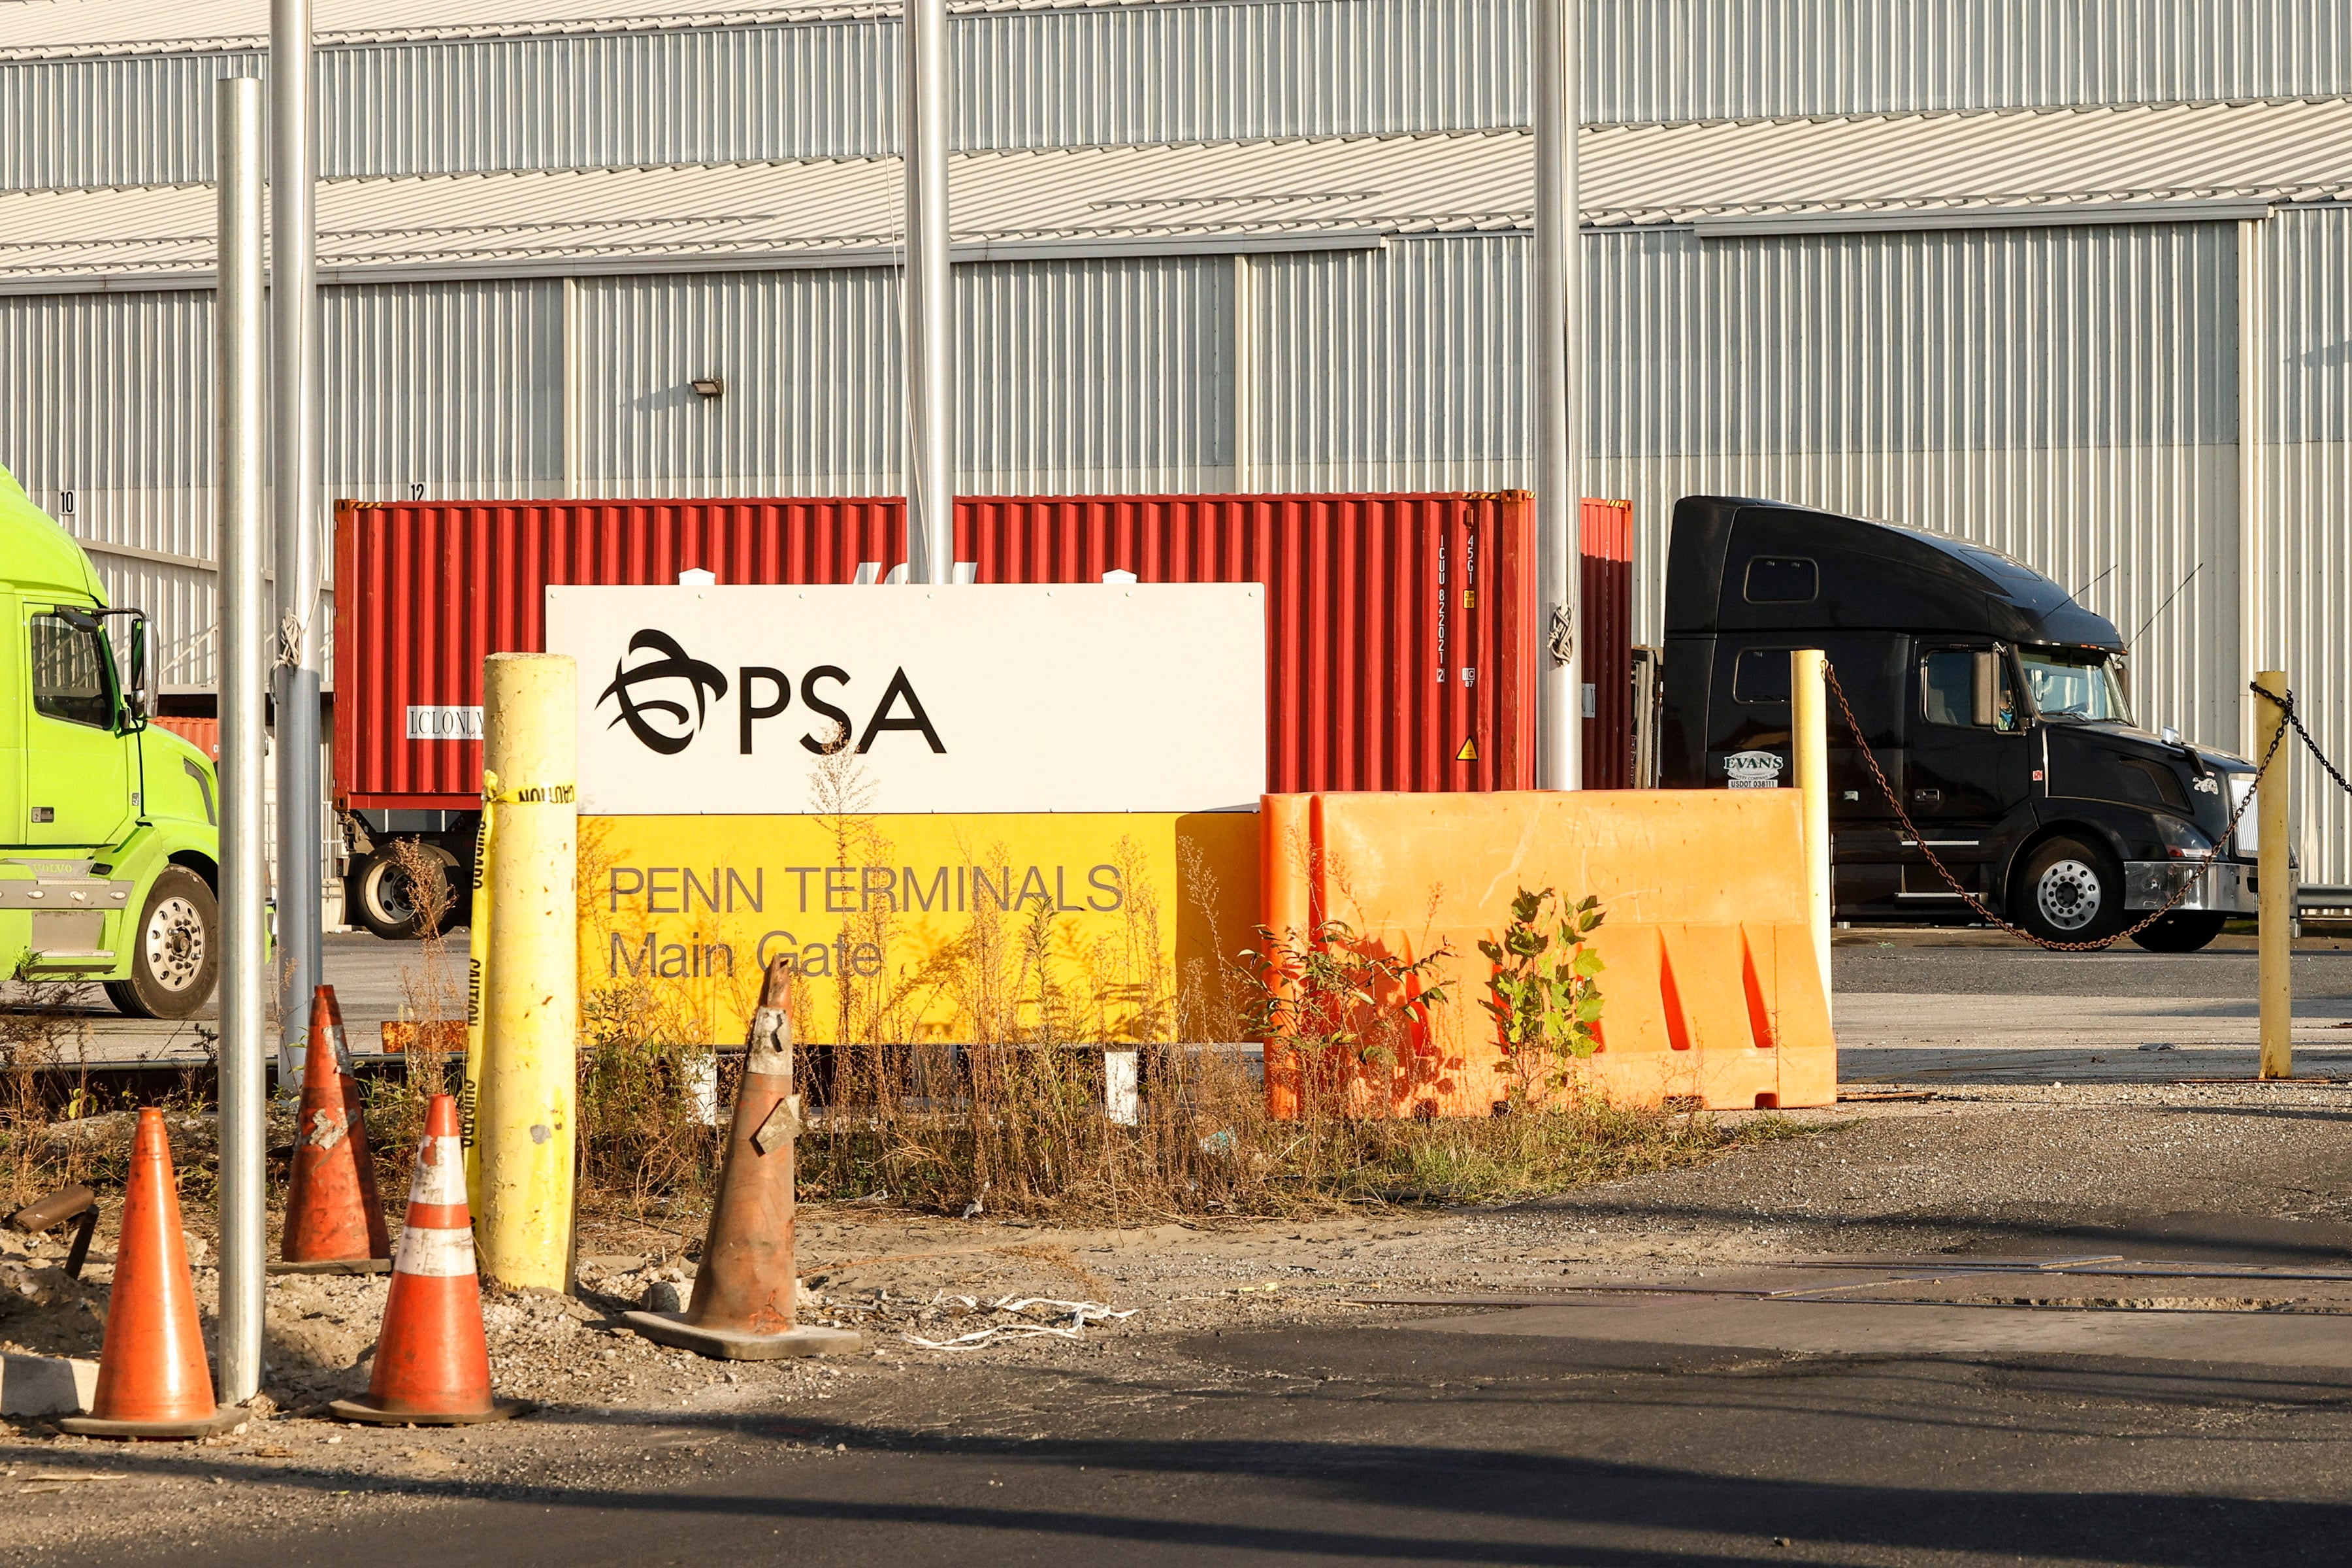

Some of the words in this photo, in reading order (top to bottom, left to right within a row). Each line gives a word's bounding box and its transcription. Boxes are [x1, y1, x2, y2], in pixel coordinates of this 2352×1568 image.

[61, 491, 73, 513] 10
[410, 483, 424, 501] 12
[1437, 669, 1445, 682] 2
[739, 665, 947, 755] PSA
[1725, 757, 1783, 768] EVANS
[31, 864, 73, 873] VOLVO
[610, 867, 763, 913] PENN
[785, 864, 1124, 913] TERMINALS
[610, 931, 734, 978] Main
[757, 930, 882, 978] Gate
